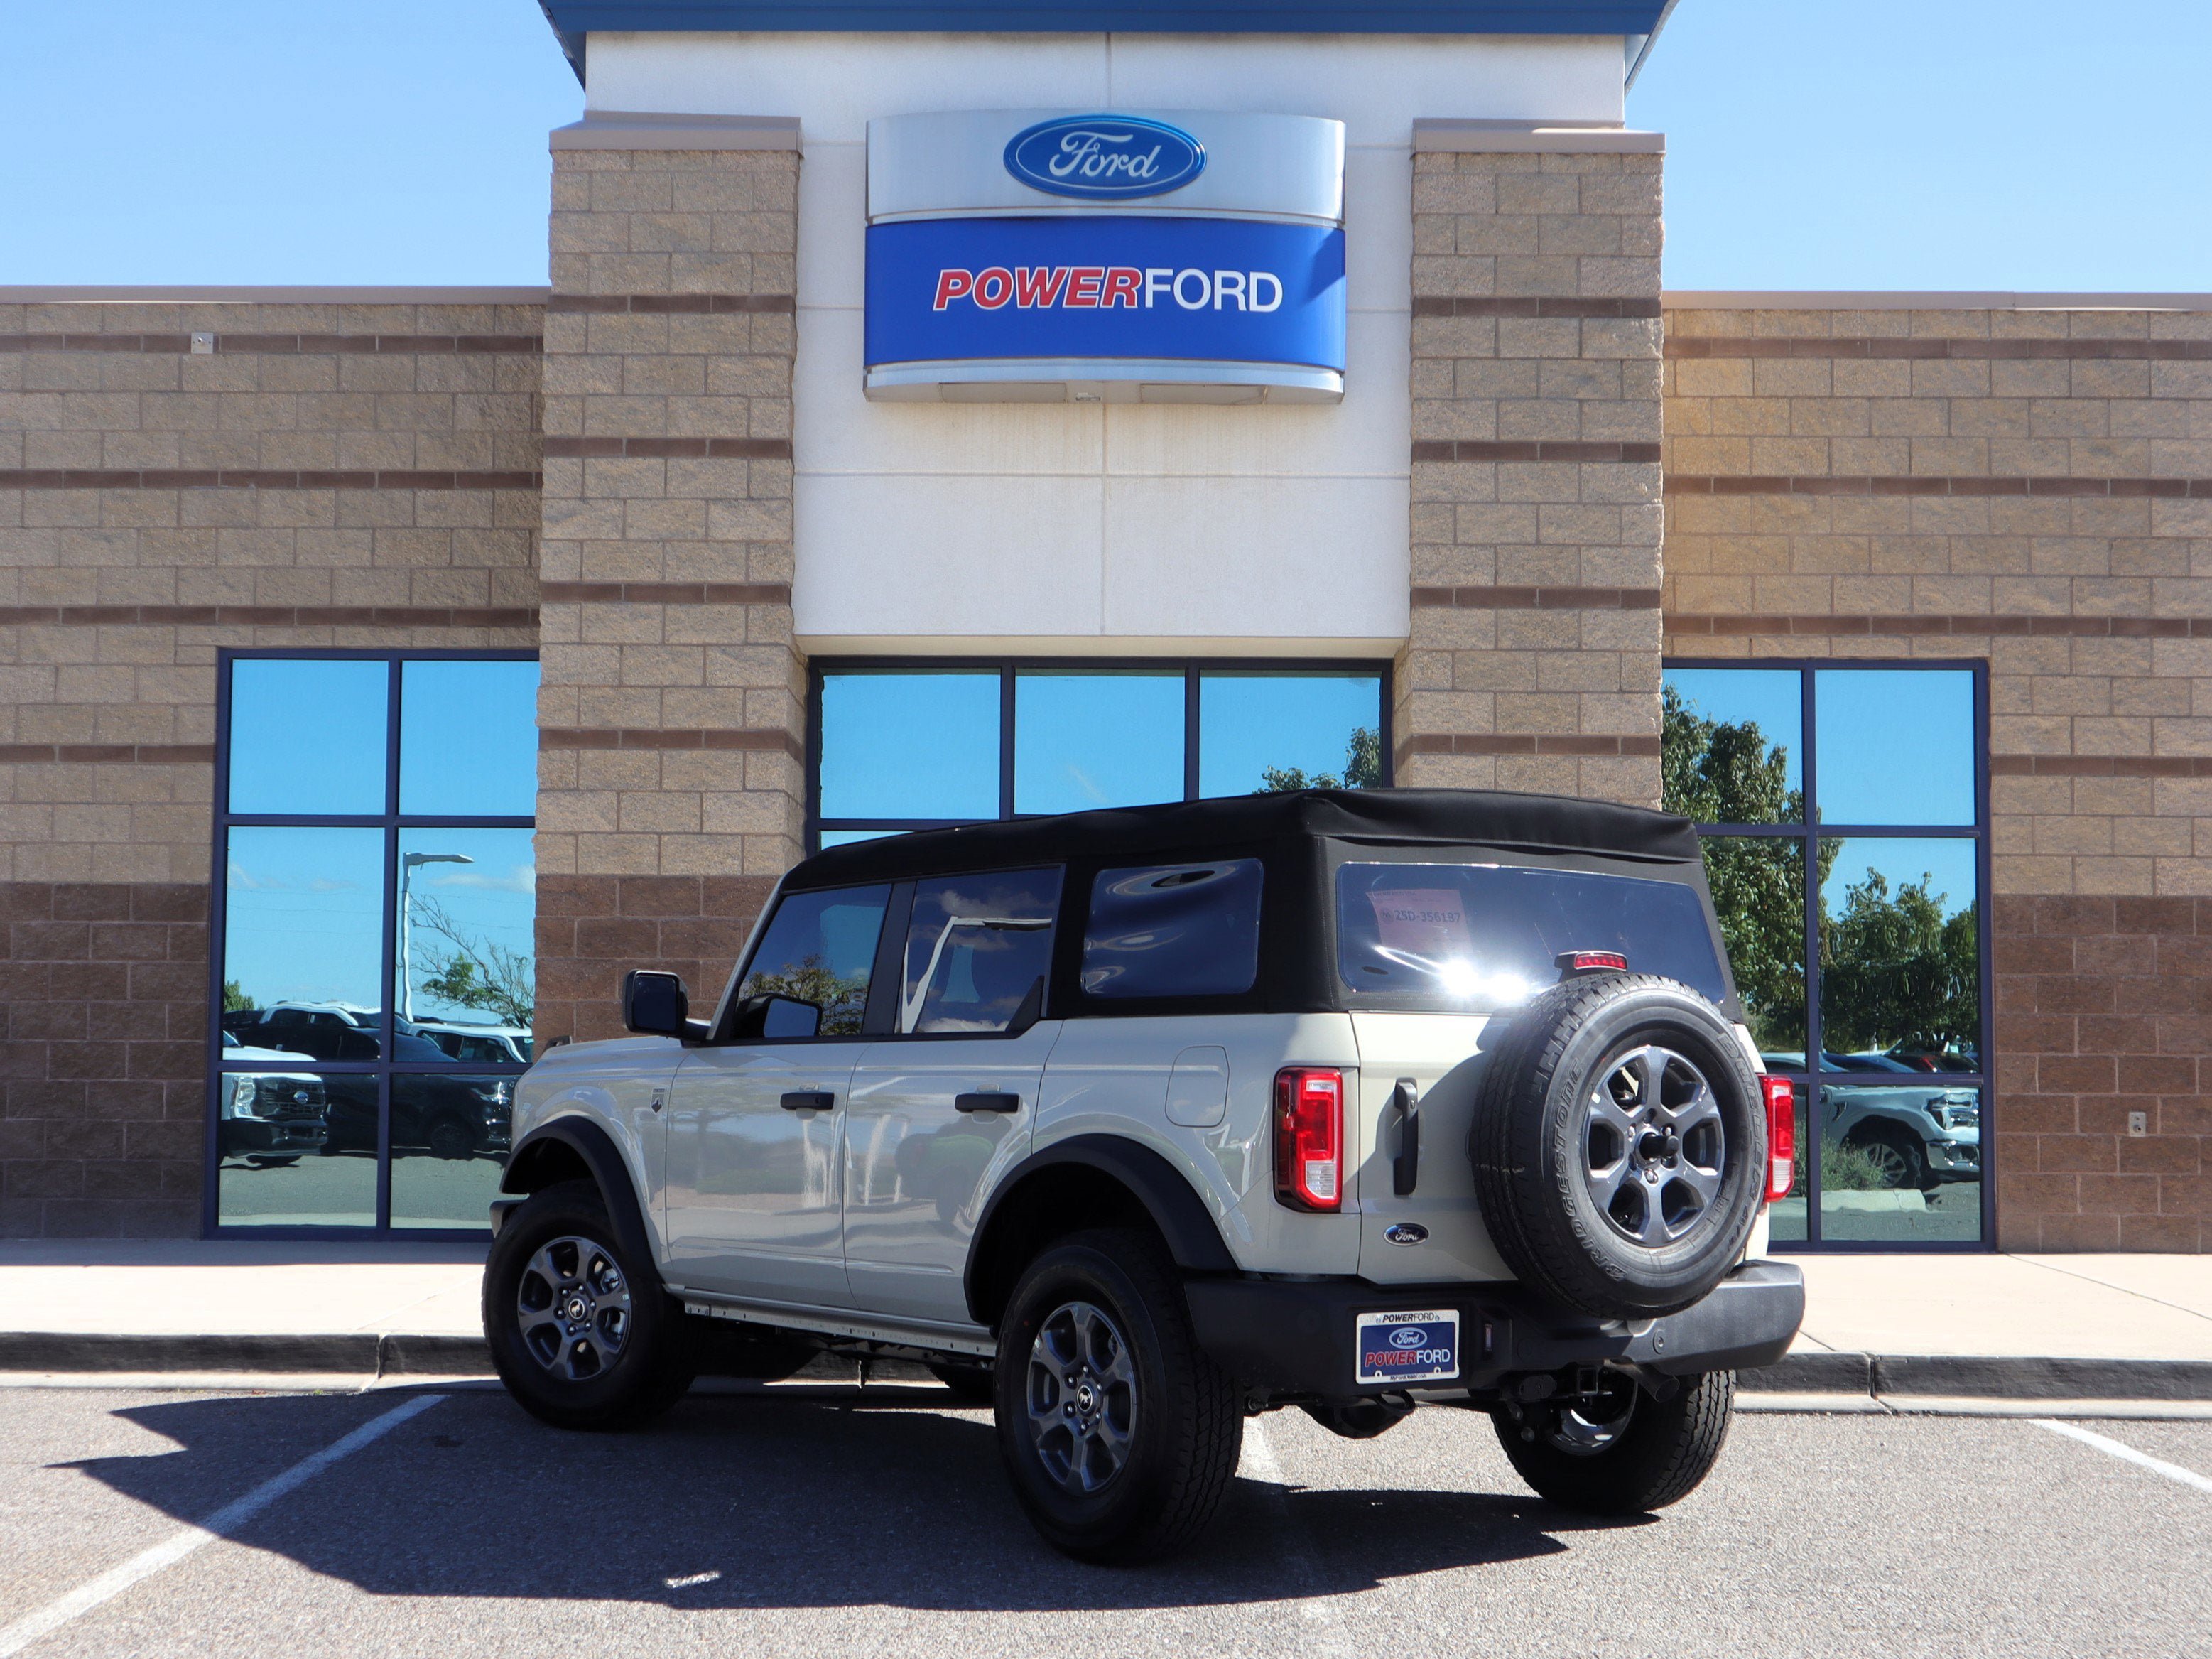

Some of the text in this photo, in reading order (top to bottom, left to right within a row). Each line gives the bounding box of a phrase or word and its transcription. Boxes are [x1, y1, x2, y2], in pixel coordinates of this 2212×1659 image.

[1048, 129, 1162, 179] Ford
[933, 266, 1284, 313] POWERFORD
[1552, 1057, 1627, 1282] BRIDGESTONE
[1395, 1228, 1419, 1241] Ford
[1382, 1312, 1435, 1323] POWERFORD
[1397, 1331, 1420, 1345] Ford
[1365, 1349, 1451, 1367] POWERFORD
